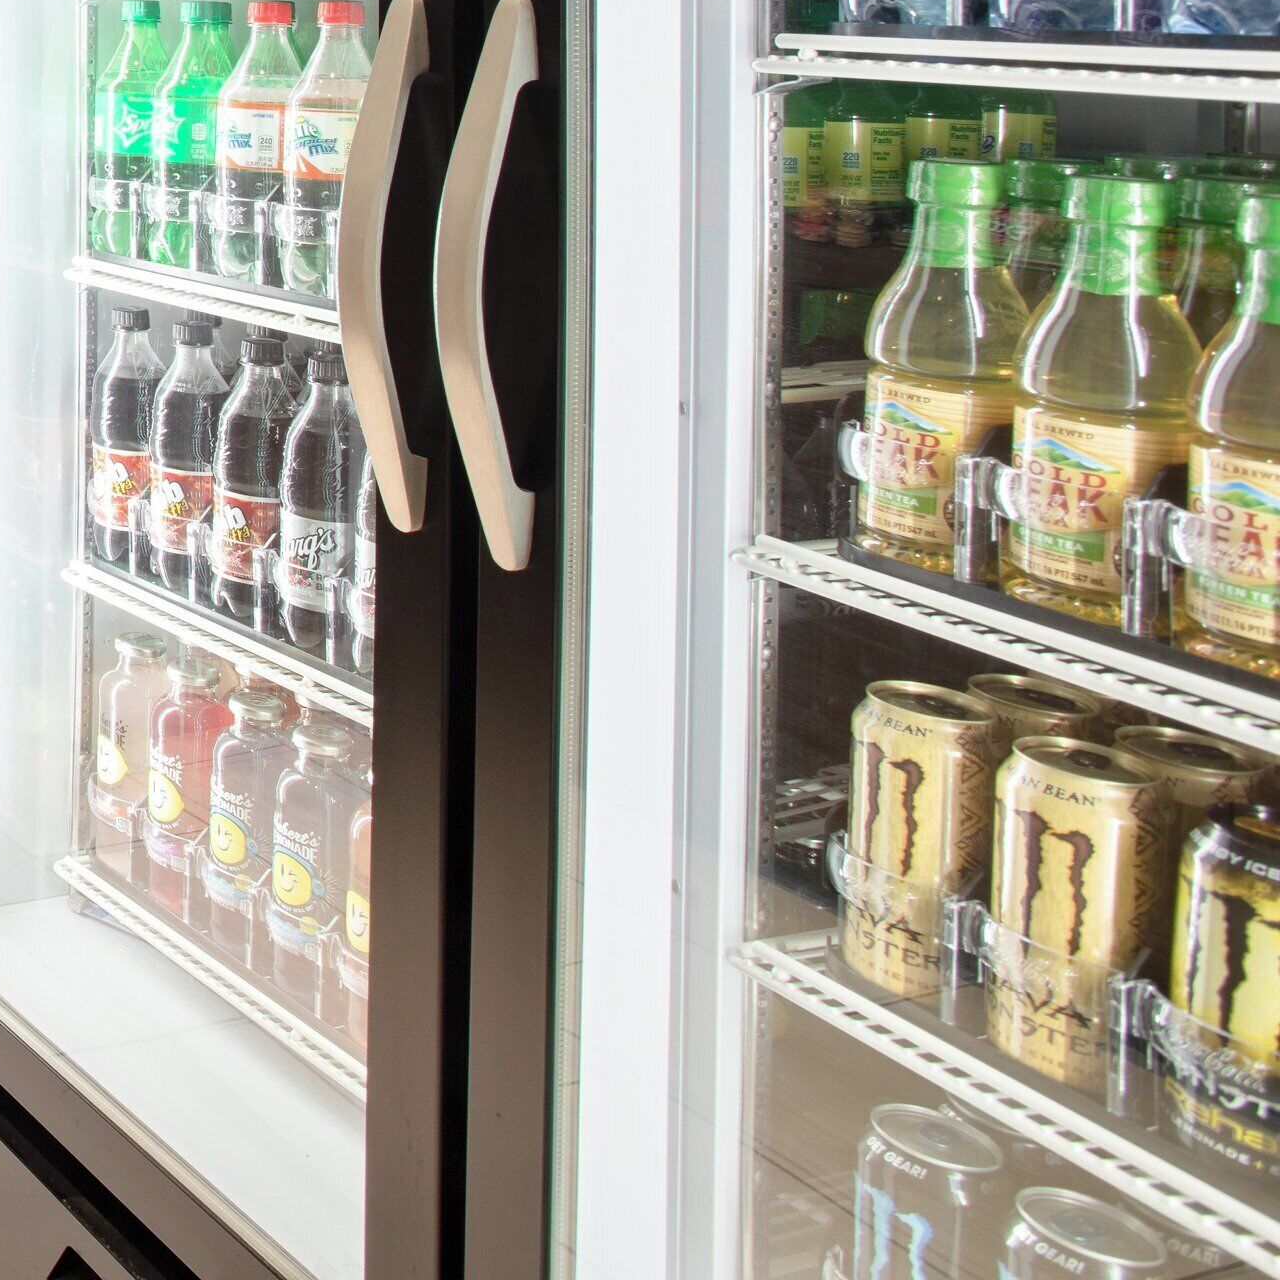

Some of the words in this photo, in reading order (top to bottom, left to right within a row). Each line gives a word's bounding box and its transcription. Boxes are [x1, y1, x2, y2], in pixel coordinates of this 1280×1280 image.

[873, 127, 900, 137] Nutrition
[951, 133, 970, 141] Facts
[260, 136, 273, 145] 240
[873, 136, 893, 145] Facts
[308, 146, 339, 157] Mix
[842, 151, 860, 162] 220
[920, 147, 937, 157] 220
[782, 156, 798, 166] 220
[888, 390, 932, 405] BREWED
[1044, 425, 1095, 441] BREWED
[1013, 453, 1108, 490] GOLD
[896, 494, 919, 507] TEA
[907, 526, 922, 536] 547
[924, 530, 937, 539] mL
[1057, 538, 1085, 553] TEA
[1071, 573, 1089, 584] 547
[1090, 577, 1105, 587] mL
[885, 715, 927, 738] BEAN
[1043, 784, 1097, 807] BEAN
[866, 1135, 887, 1154] GET
[883, 1151, 928, 1181] GEAR!
[1034, 1238, 1085, 1275] GEAR!
[1165, 1238, 1221, 1267] GEAR!
